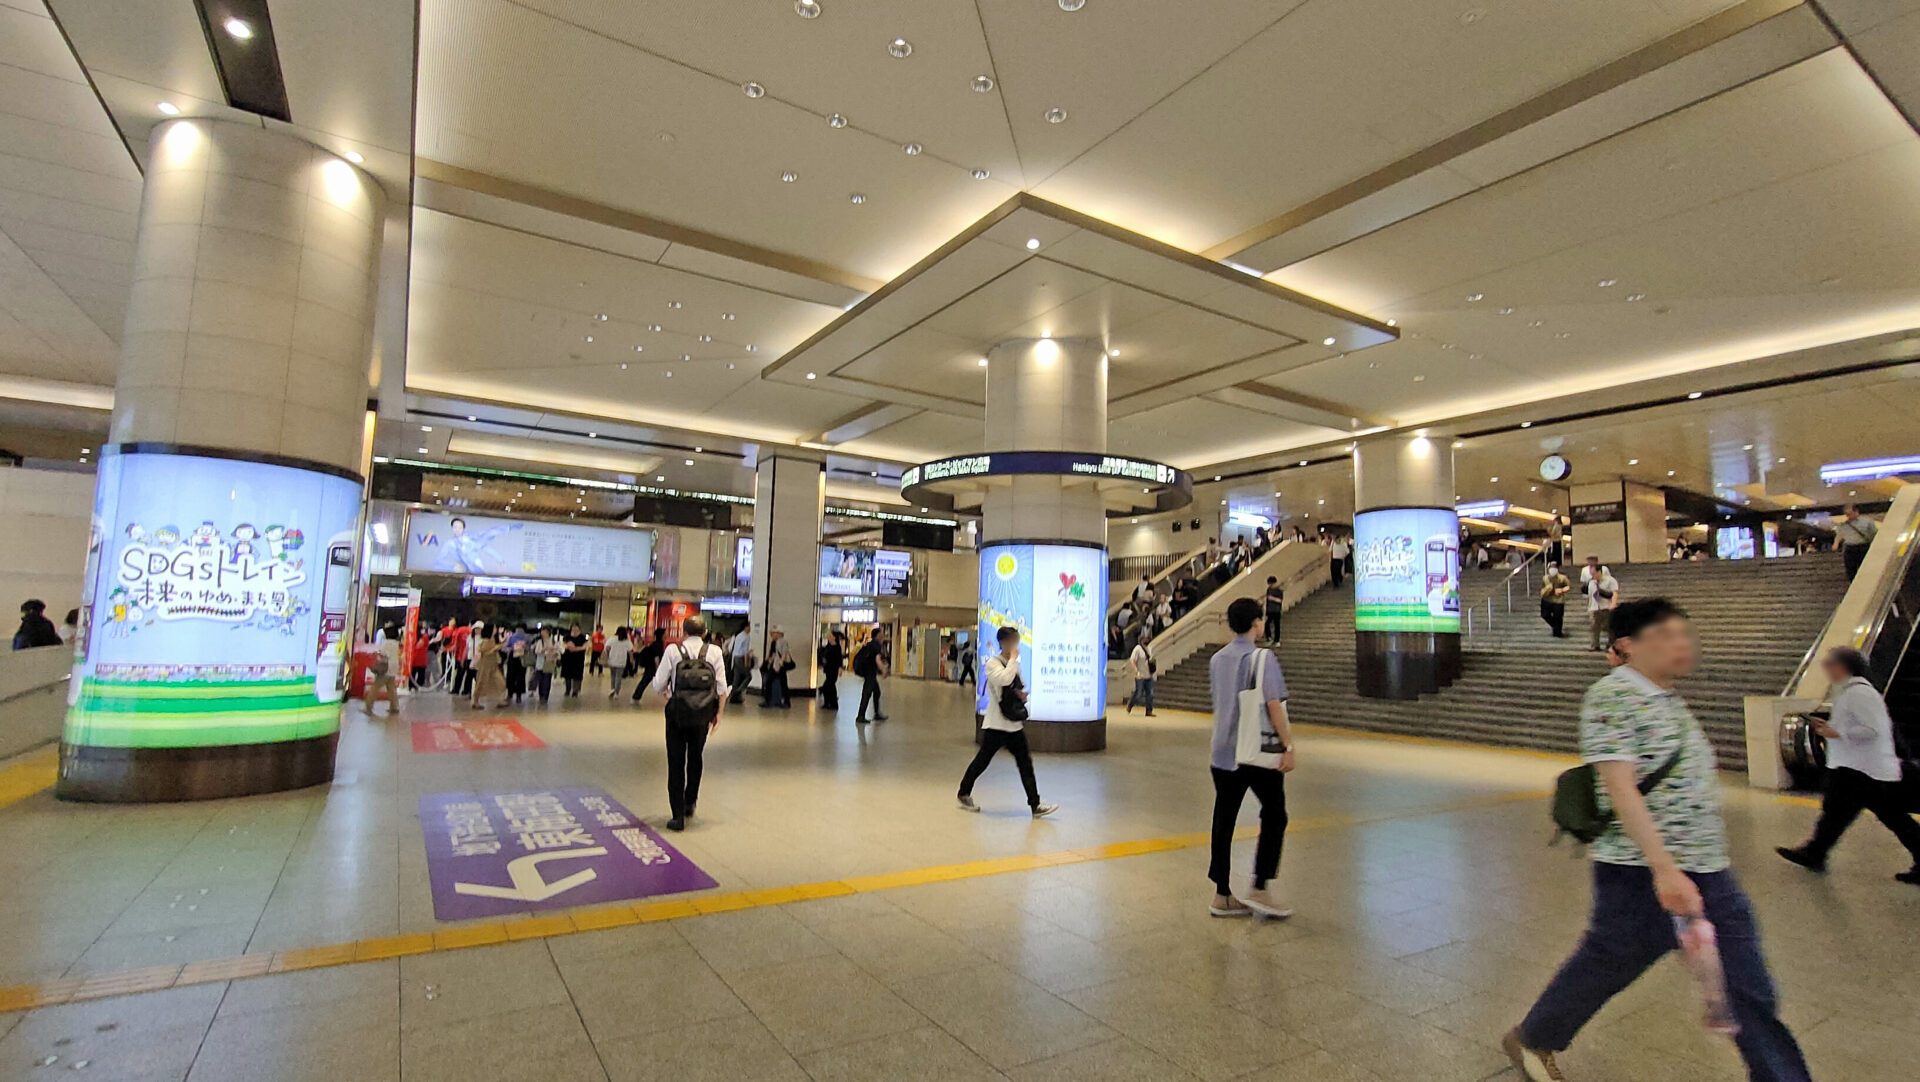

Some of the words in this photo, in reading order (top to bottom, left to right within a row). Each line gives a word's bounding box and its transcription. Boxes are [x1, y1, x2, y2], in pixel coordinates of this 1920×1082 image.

[1072, 462, 1097, 474] Hankyu
[122, 548, 301, 588] SDGsトレイン
[133, 578, 286, 613] 未来のゆめ・まち号
